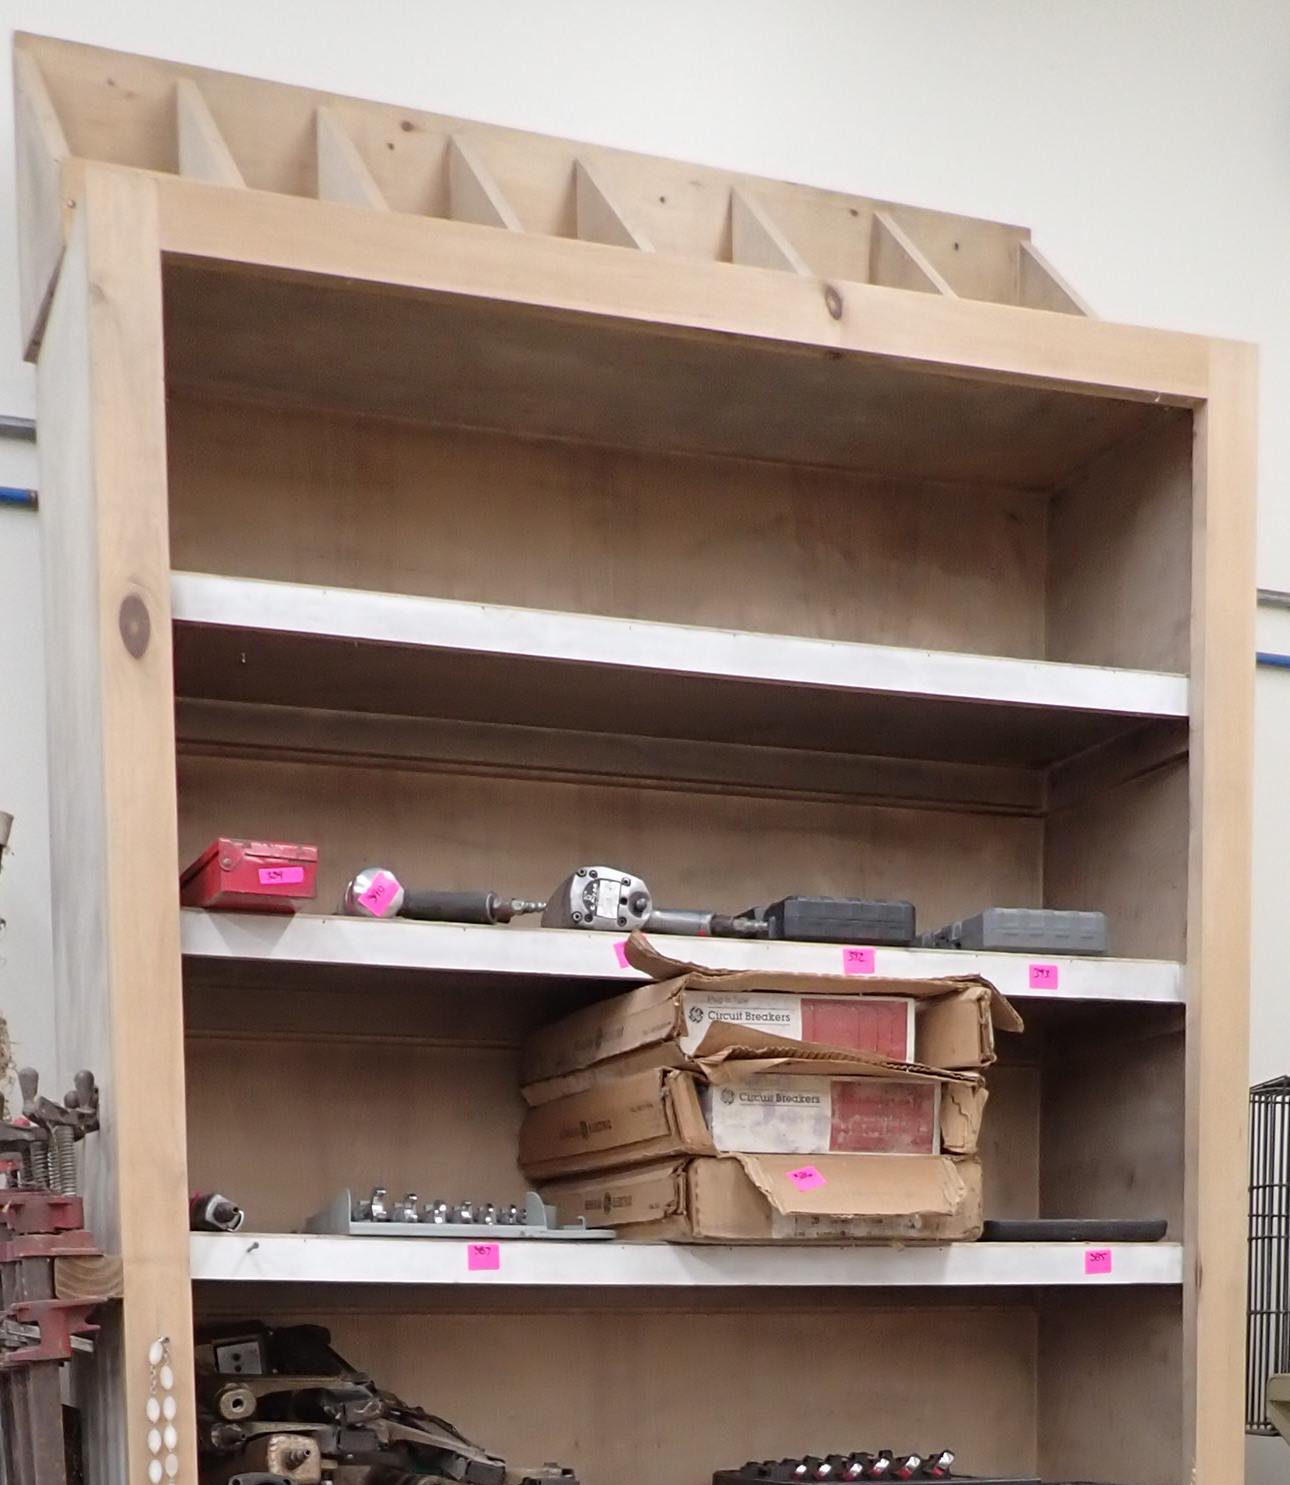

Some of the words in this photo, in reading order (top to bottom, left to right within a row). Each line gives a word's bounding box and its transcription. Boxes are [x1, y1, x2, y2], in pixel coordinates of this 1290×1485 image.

[708, 1010, 742, 1021] Circuit
[745, 1011, 791, 1022] Breakers
[739, 1093, 772, 1104] Circuit
[775, 1093, 820, 1104] Breakers
